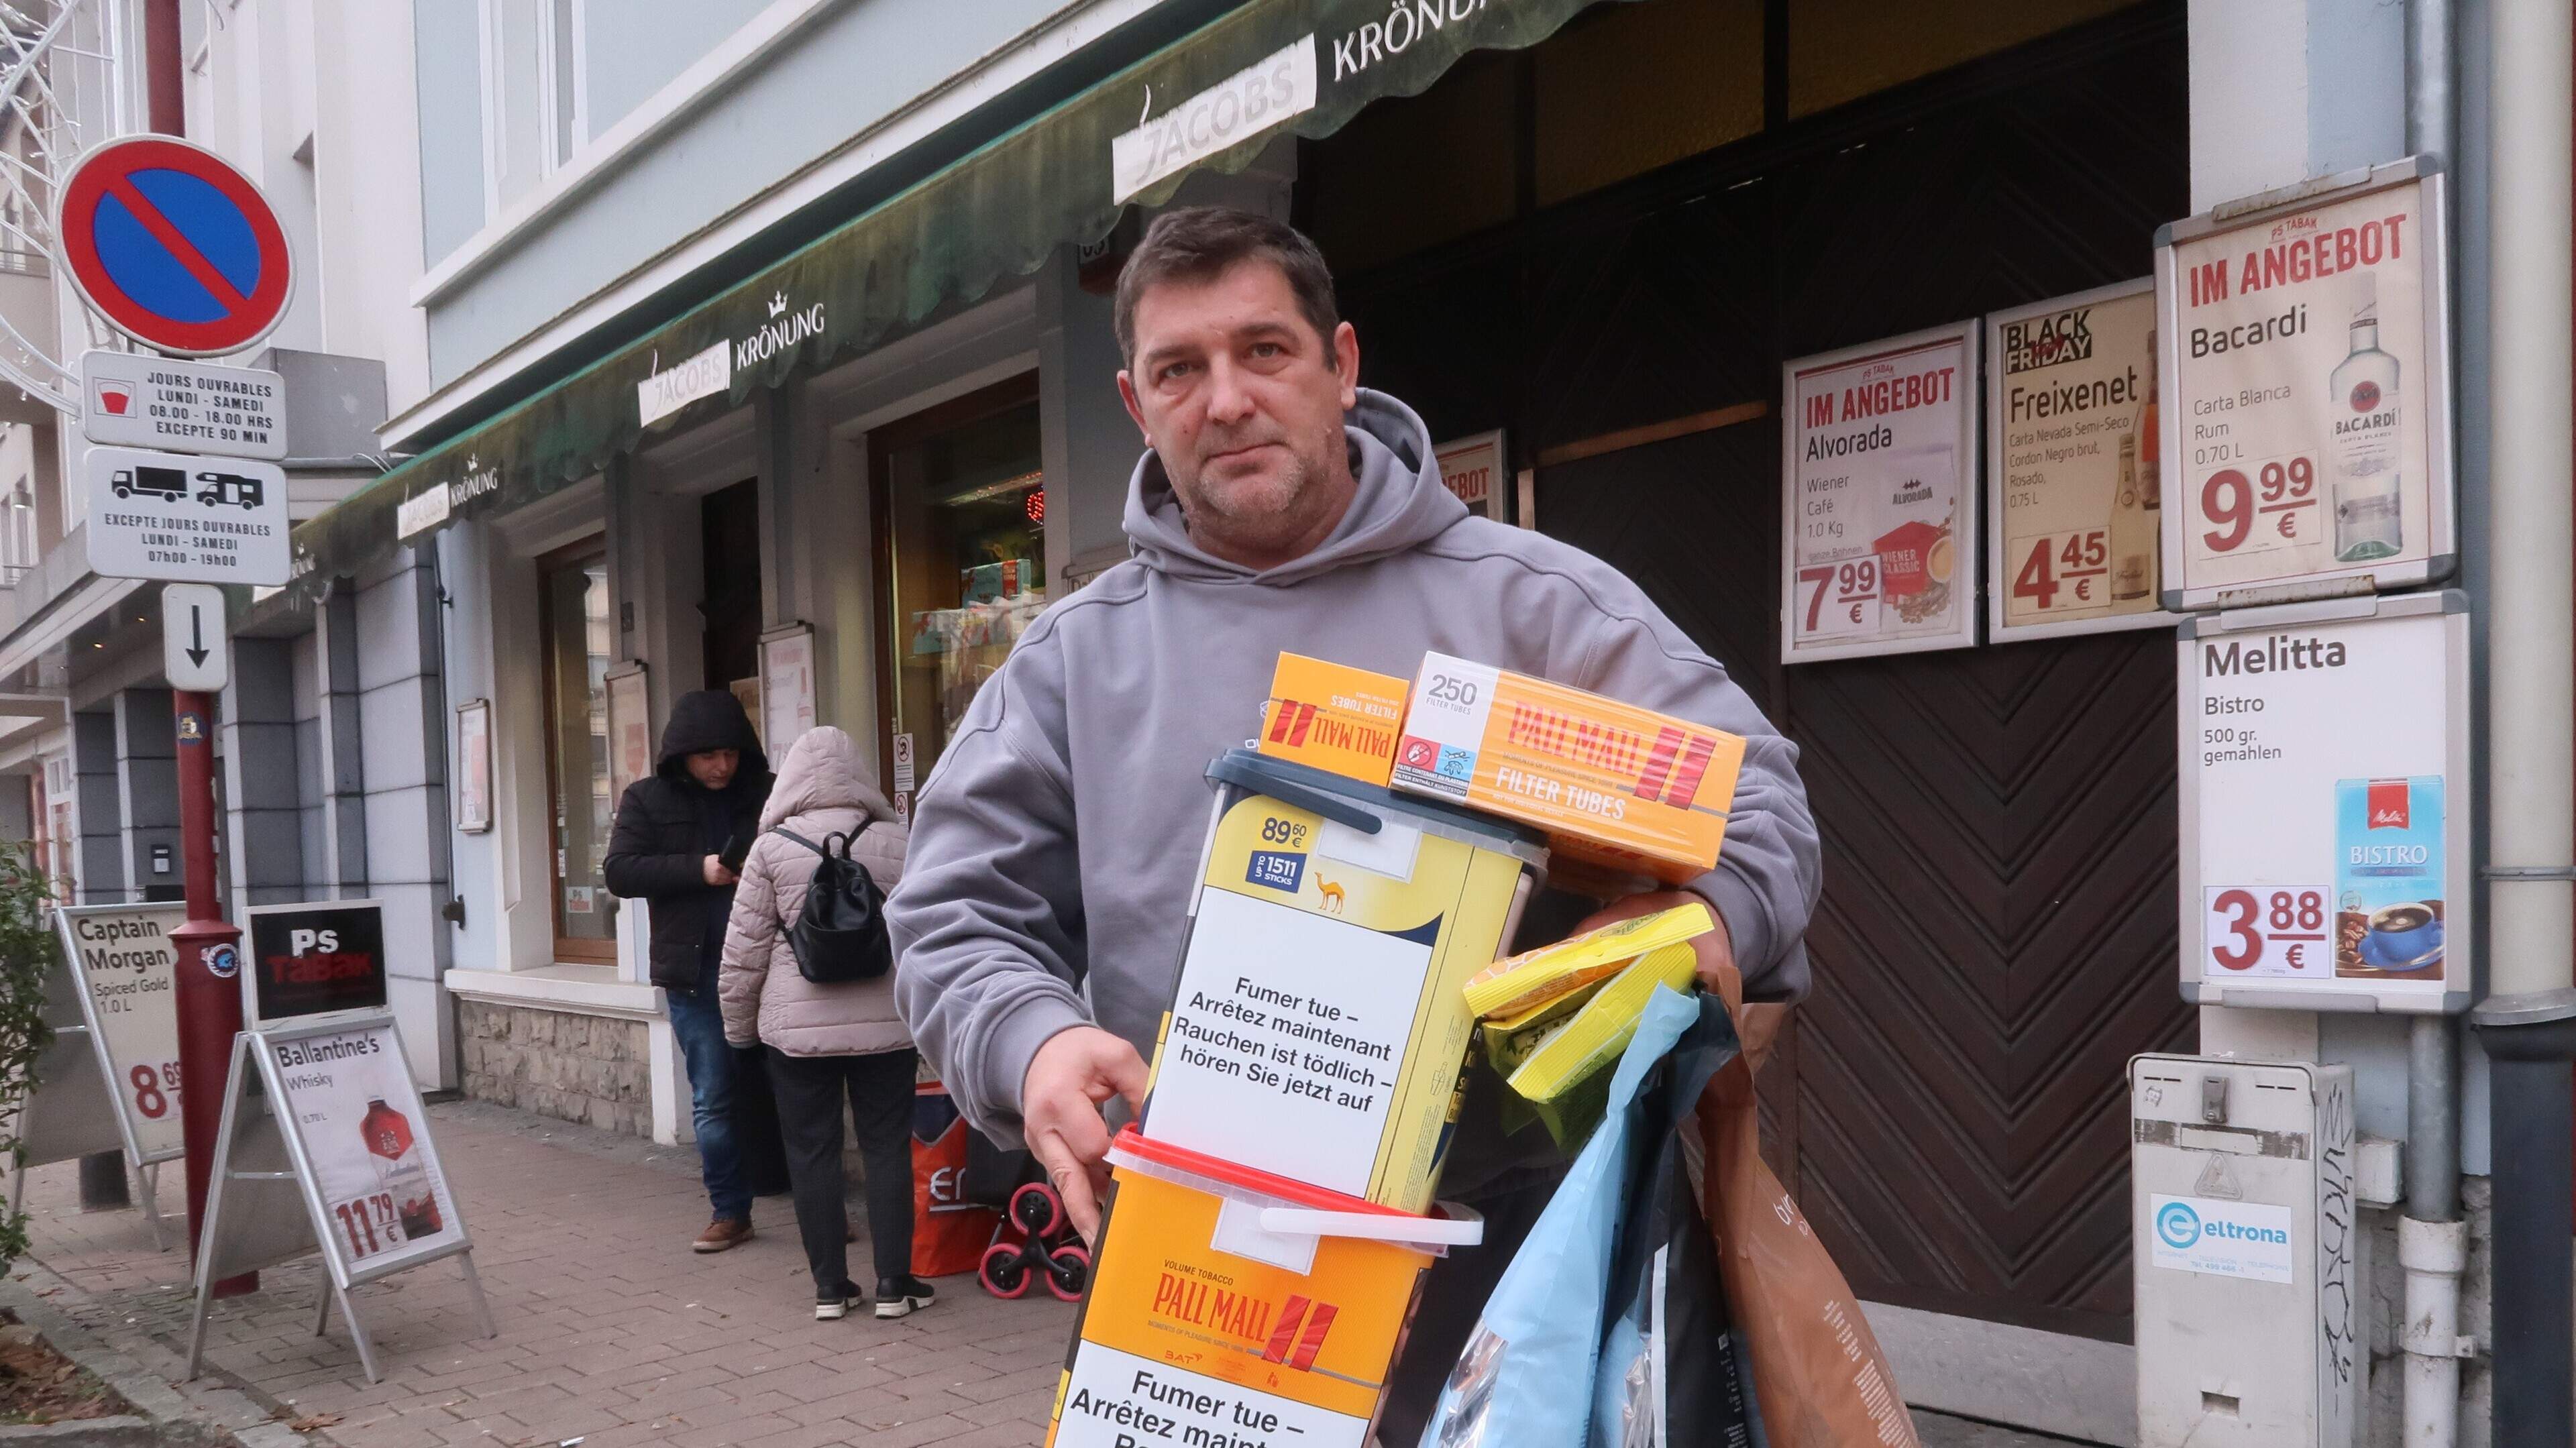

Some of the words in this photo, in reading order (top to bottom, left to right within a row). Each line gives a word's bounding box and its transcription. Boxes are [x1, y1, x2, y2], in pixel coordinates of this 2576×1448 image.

[2190, 259, 2228, 308] IM
[2240, 213, 2407, 295] ANGEBOT
[737, 303, 824, 372] KRÖNUNG
[2006, 309, 2092, 353] BLACK
[2191, 303, 2307, 359] Bacardi
[2007, 336, 2090, 373] FRIDAY
[148, 372, 191, 388] JOURS
[198, 378, 272, 398] OUVRABLES
[1807, 393, 1833, 429] IM
[1841, 367, 1955, 422] ANGEBOT
[2011, 366, 2138, 423] Freixenet
[158, 389, 198, 404] LUNDI
[214, 396, 264, 412] SAMEDI
[2194, 394, 2234, 416] Carta
[2239, 384, 2292, 408] Blanca
[150, 405, 189, 420] 08.00
[206, 410, 241, 425] 18.00
[248, 416, 272, 429] HRS
[157, 421, 215, 439] EXCEPTE
[221, 429, 237, 441] 90
[243, 431, 268, 444] MIN
[1806, 423, 1892, 463] Alvorada
[2009, 432, 2034, 447] Carta
[2037, 427, 2072, 442] Nevada
[2075, 416, 2129, 436] Semi-Seco
[2195, 422, 2229, 441] Rum
[2009, 451, 2042, 468] Cordon
[2045, 446, 2075, 464] Negro
[2195, 445, 2229, 465] 0.70
[2235, 443, 2244, 459] L
[450, 467, 498, 508] KRÖNUNG
[1807, 475, 1850, 494] Wiener
[1807, 498, 1834, 517] Café
[2009, 493, 2030, 508] 0.75
[2032, 494, 2039, 505] L
[2201, 468, 2252, 553] 9
[2259, 456, 2314, 502] 99
[105, 512, 158, 528] EXCEPTE
[161, 518, 199, 531] JOURS
[203, 520, 270, 537] OUVRABLES
[1807, 522, 1824, 538] 1.0
[1828, 520, 1843, 537] Kg
[2277, 512, 2297, 539] €
[142, 534, 178, 546] LUNDI
[193, 537, 237, 550] SAMEDI
[148, 551, 186, 563] 07h00
[201, 554, 236, 567] 19h00
[1880, 549, 1917, 563] WIENER
[1882, 561, 1921, 574] CLASSIC
[2013, 538, 2059, 609] 4
[2060, 531, 2106, 567] 45
[1799, 566, 1835, 631] 7
[1839, 560, 1876, 594] 99
[2075, 577, 2091, 601] €
[1849, 603, 1863, 624] €
[2205, 634, 2347, 677] Melitta
[1330, 694, 1362, 712] TUBES
[1428, 674, 1478, 705] 250
[1364, 702, 1398, 720] FILTER
[1426, 698, 1449, 710] FILTER
[1450, 704, 1471, 716] TUBES
[2204, 695, 2264, 716] Bistro
[1313, 716, 1354, 750] MALL
[1356, 726, 1391, 759] PALL
[1507, 700, 1571, 759] PALL
[1571, 719, 1642, 778] MALL
[2204, 728, 2234, 744] 500
[2239, 728, 2257, 746] gr.
[2204, 745, 2282, 767] gemahlen
[1495, 766, 1560, 803] FILTER
[1566, 784, 1625, 820] TUBES
[1262, 817, 1291, 844] 89
[1292, 824, 1307, 836] 60
[1292, 837, 1302, 848] €
[1267, 856, 1297, 877] 1511
[2350, 845, 2428, 865] BISTRO
[1264, 873, 1293, 885] STICKS
[77, 915, 160, 946] Captain
[290, 928, 339, 959] PS
[2211, 889, 2263, 971] 3
[2269, 891, 2322, 930] 88
[85, 948, 169, 974] Morgan
[2285, 943, 2304, 970] €
[95, 979, 136, 999] Spiced
[140, 977, 168, 993] Gold
[1234, 977, 1303, 1010] Fumer
[1307, 997, 1341, 1021] tue
[101, 999, 121, 1013] 1.0
[124, 998, 132, 1011] L
[1189, 991, 1266, 1027] Arrêtez
[1272, 1016, 1392, 1061] maintenant
[276, 1032, 380, 1067] Ballantine's
[1174, 1017, 1265, 1057] Rauchen
[1271, 1043, 1297, 1066] ist
[1303, 1052, 1375, 1087] tödlich
[130, 1065, 167, 1119] 8
[286, 1072, 333, 1091] Whisky
[1179, 1044, 1241, 1076] hören
[1246, 1062, 1280, 1087] Sie
[1283, 1073, 1333, 1103] jetzt
[1336, 1091, 1373, 1113] auf
[336, 1198, 380, 1258] 11
[368, 1193, 394, 1223] 79
[386, 1225, 398, 1242] €
[2204, 1221, 2287, 1244] eltrona
[1165, 1259, 1197, 1276] VOLUME
[1198, 1268, 1234, 1286] TOBACCO
[1152, 1272, 1208, 1325] PALL
[1208, 1288, 1271, 1343] MALL
[1165, 1350, 1193, 1364] BAT
[1071, 1387, 1177, 1439] Arrêtez
[1132, 1370, 1226, 1418] Fumer
[1233, 1397, 1279, 1434] tue
